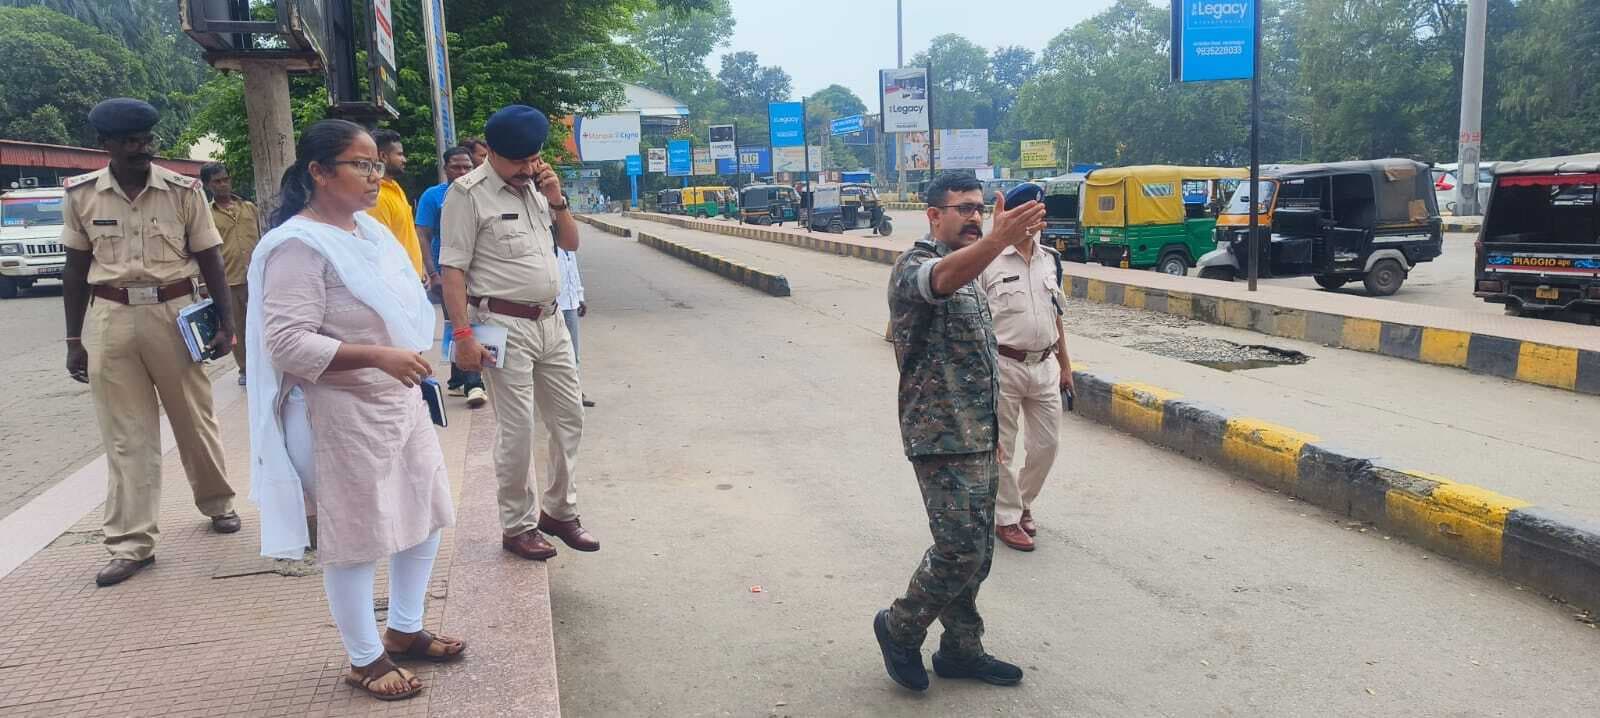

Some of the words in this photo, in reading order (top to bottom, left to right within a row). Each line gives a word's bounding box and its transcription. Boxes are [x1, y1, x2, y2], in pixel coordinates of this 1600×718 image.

[1198, 2, 1248, 19] Legacy
[893, 104, 923, 114] Legacy
[1513, 257, 1556, 266] PIAGGIO
